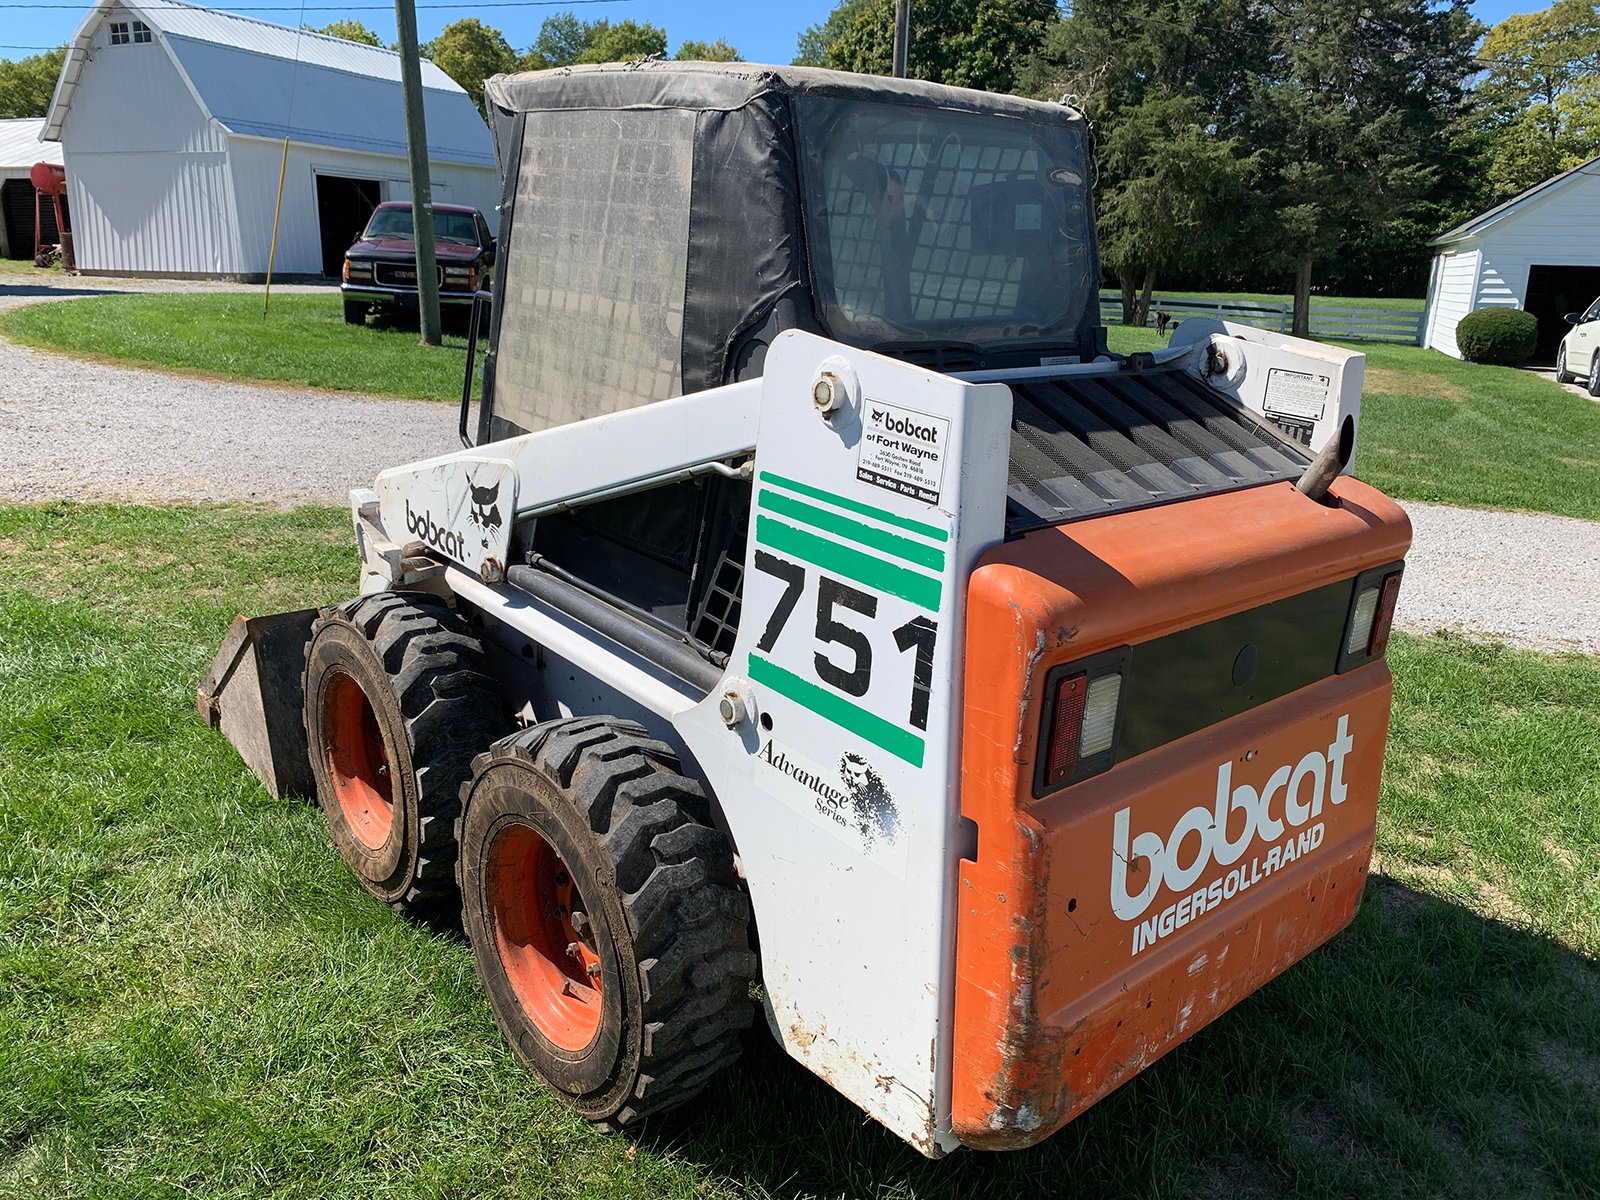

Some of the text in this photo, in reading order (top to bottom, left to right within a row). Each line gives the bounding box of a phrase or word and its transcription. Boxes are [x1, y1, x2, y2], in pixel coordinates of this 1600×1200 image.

[1284, 372, 1314, 381] IMPORTANT
[885, 412, 938, 443] bobcat
[876, 435, 900, 450] Fort
[901, 442, 939, 462] Wayne
[909, 459, 922, 467] Road
[858, 470, 938, 503] Sales Service Parts Rental
[406, 498, 465, 563] bobcat
[754, 549, 939, 732] 751
[757, 739, 849, 810] Advantage
[814, 797, 848, 827] Series
[1110, 713, 1354, 921] bobcat
